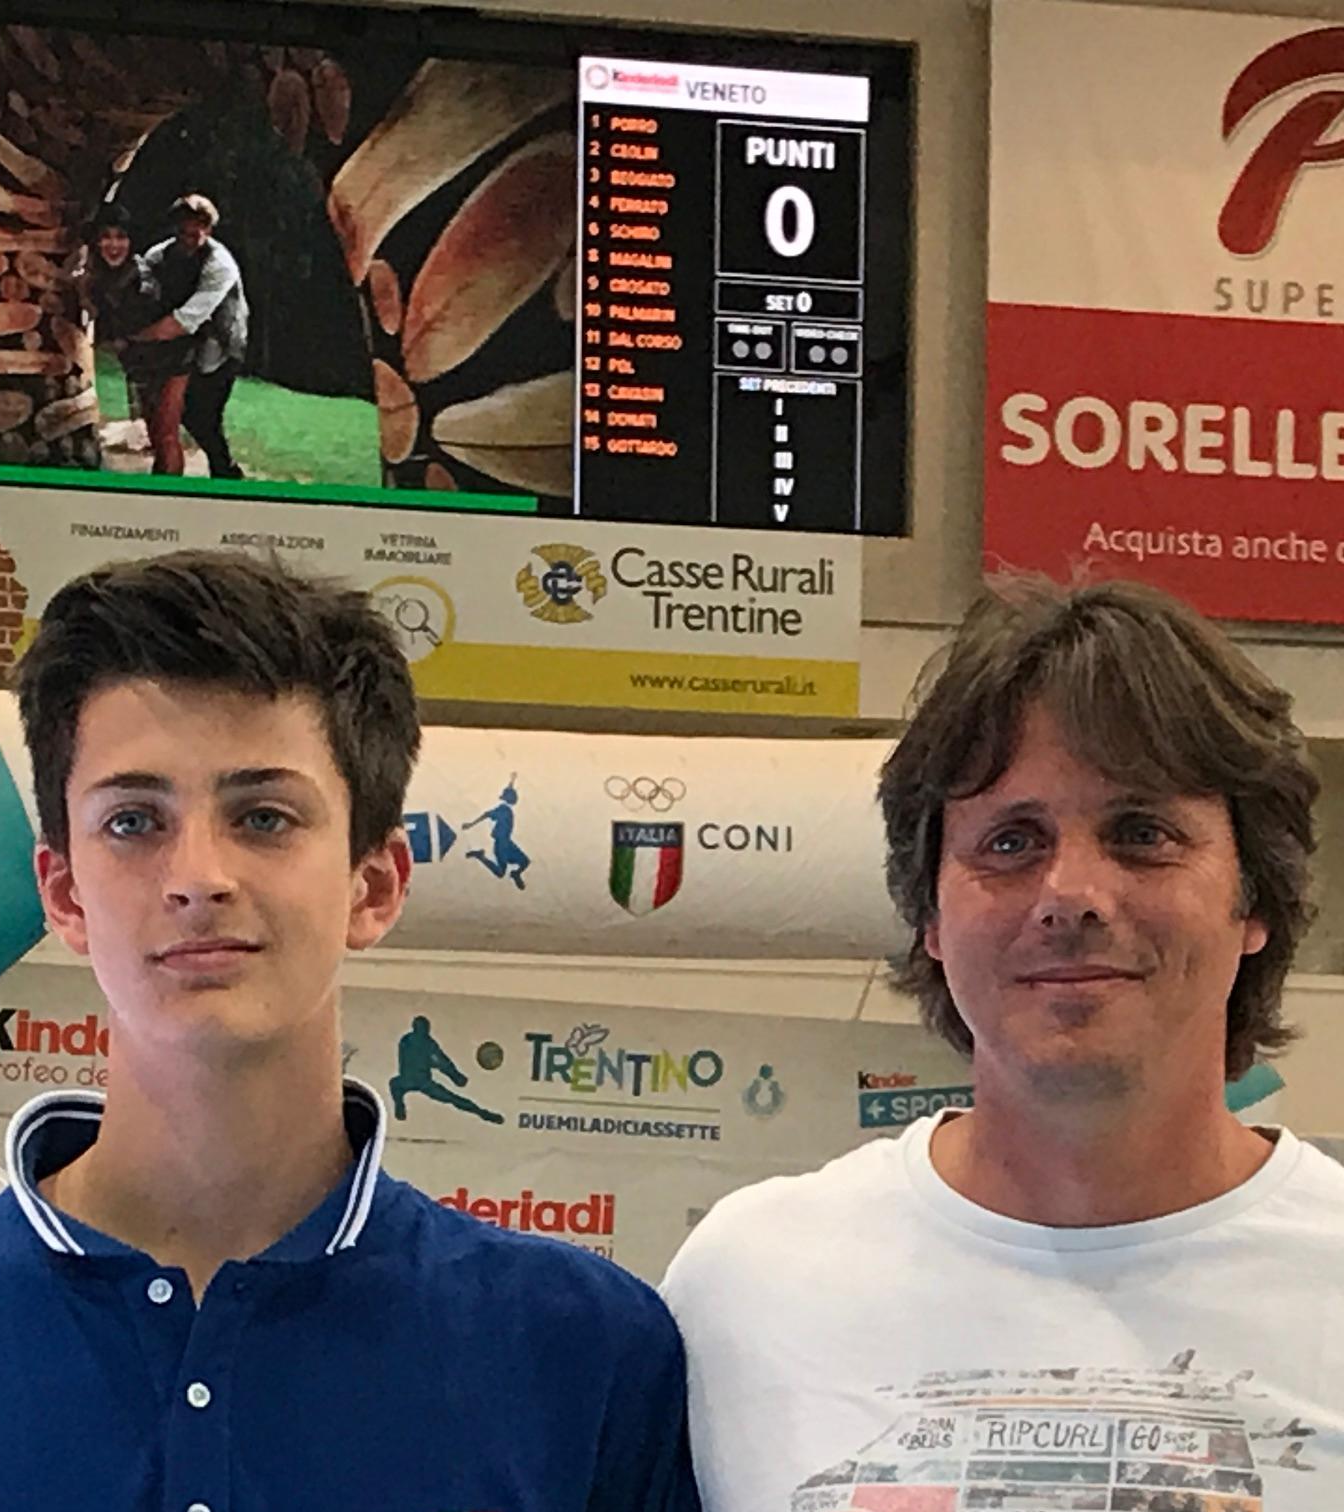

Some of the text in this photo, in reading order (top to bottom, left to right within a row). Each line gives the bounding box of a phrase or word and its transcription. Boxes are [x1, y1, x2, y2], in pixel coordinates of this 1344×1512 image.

[686, 79, 767, 105] VENETO
[589, 141, 601, 156] 2
[746, 136, 836, 170] PUNTI
[764, 185, 816, 258] 0
[766, 292, 813, 313] SET 0
[70, 523, 180, 543] FINANZIAMENTI
[380, 532, 438, 549] VETRINA
[1084, 520, 1225, 562] Acquista
[1232, 530, 1328, 564] anche
[363, 547, 453, 567] IMMOBILIARE
[610, 546, 834, 597] Casse Rurali
[643, 590, 803, 636] Trentine
[617, 823, 794, 854] ITALIA CONI
[524, 1032, 724, 1097] TRENTINO
[518, 1112, 721, 1141] DUEMILADICIASSETTE
[1130, 1420, 1161, 1451] GO
